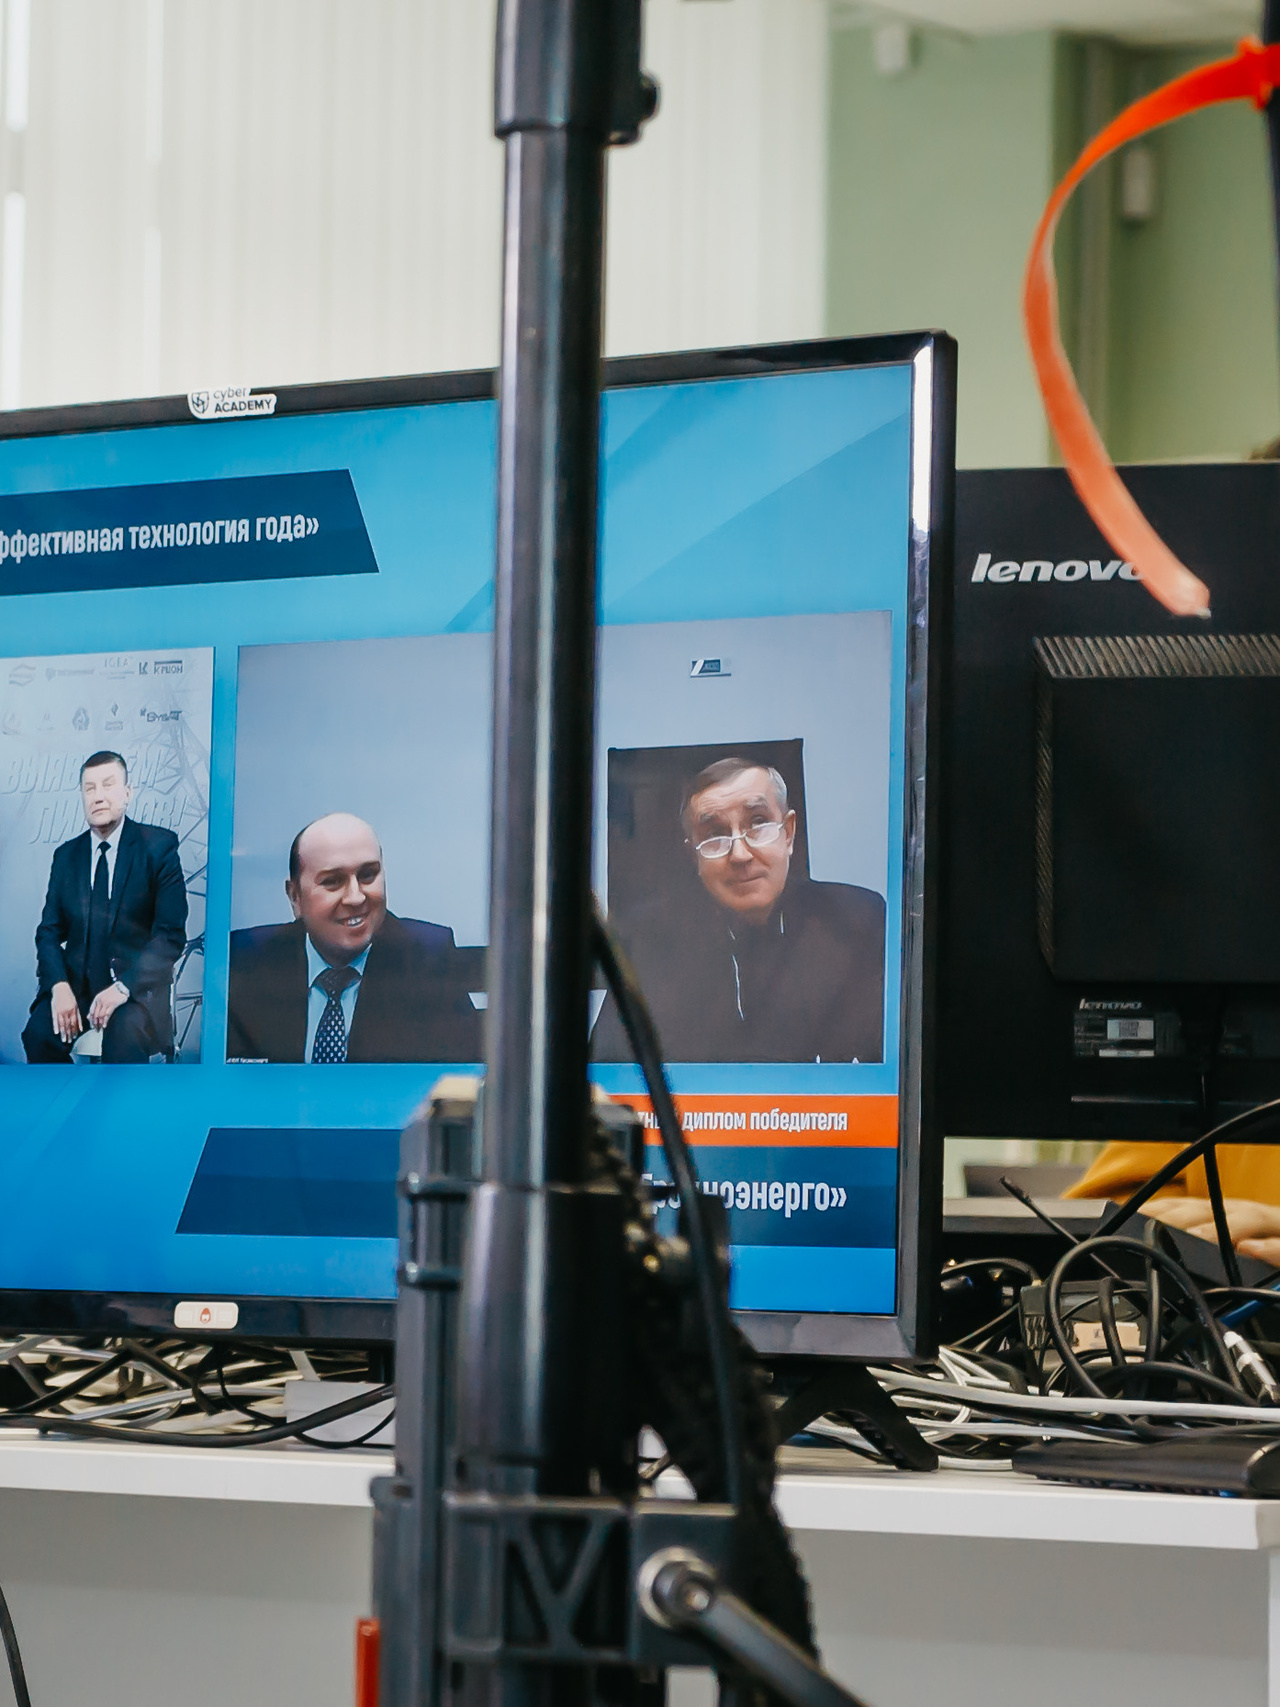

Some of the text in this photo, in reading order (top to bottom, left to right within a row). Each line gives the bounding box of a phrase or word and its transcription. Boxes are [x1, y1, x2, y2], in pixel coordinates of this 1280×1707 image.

[213, 387, 247, 402] cyber
[214, 398, 272, 414] ACADEMY
[129, 518, 250, 550] технология
[255, 514, 319, 543] года»
[681, 1111, 746, 1132] диплом
[750, 1108, 848, 1132] победителя
